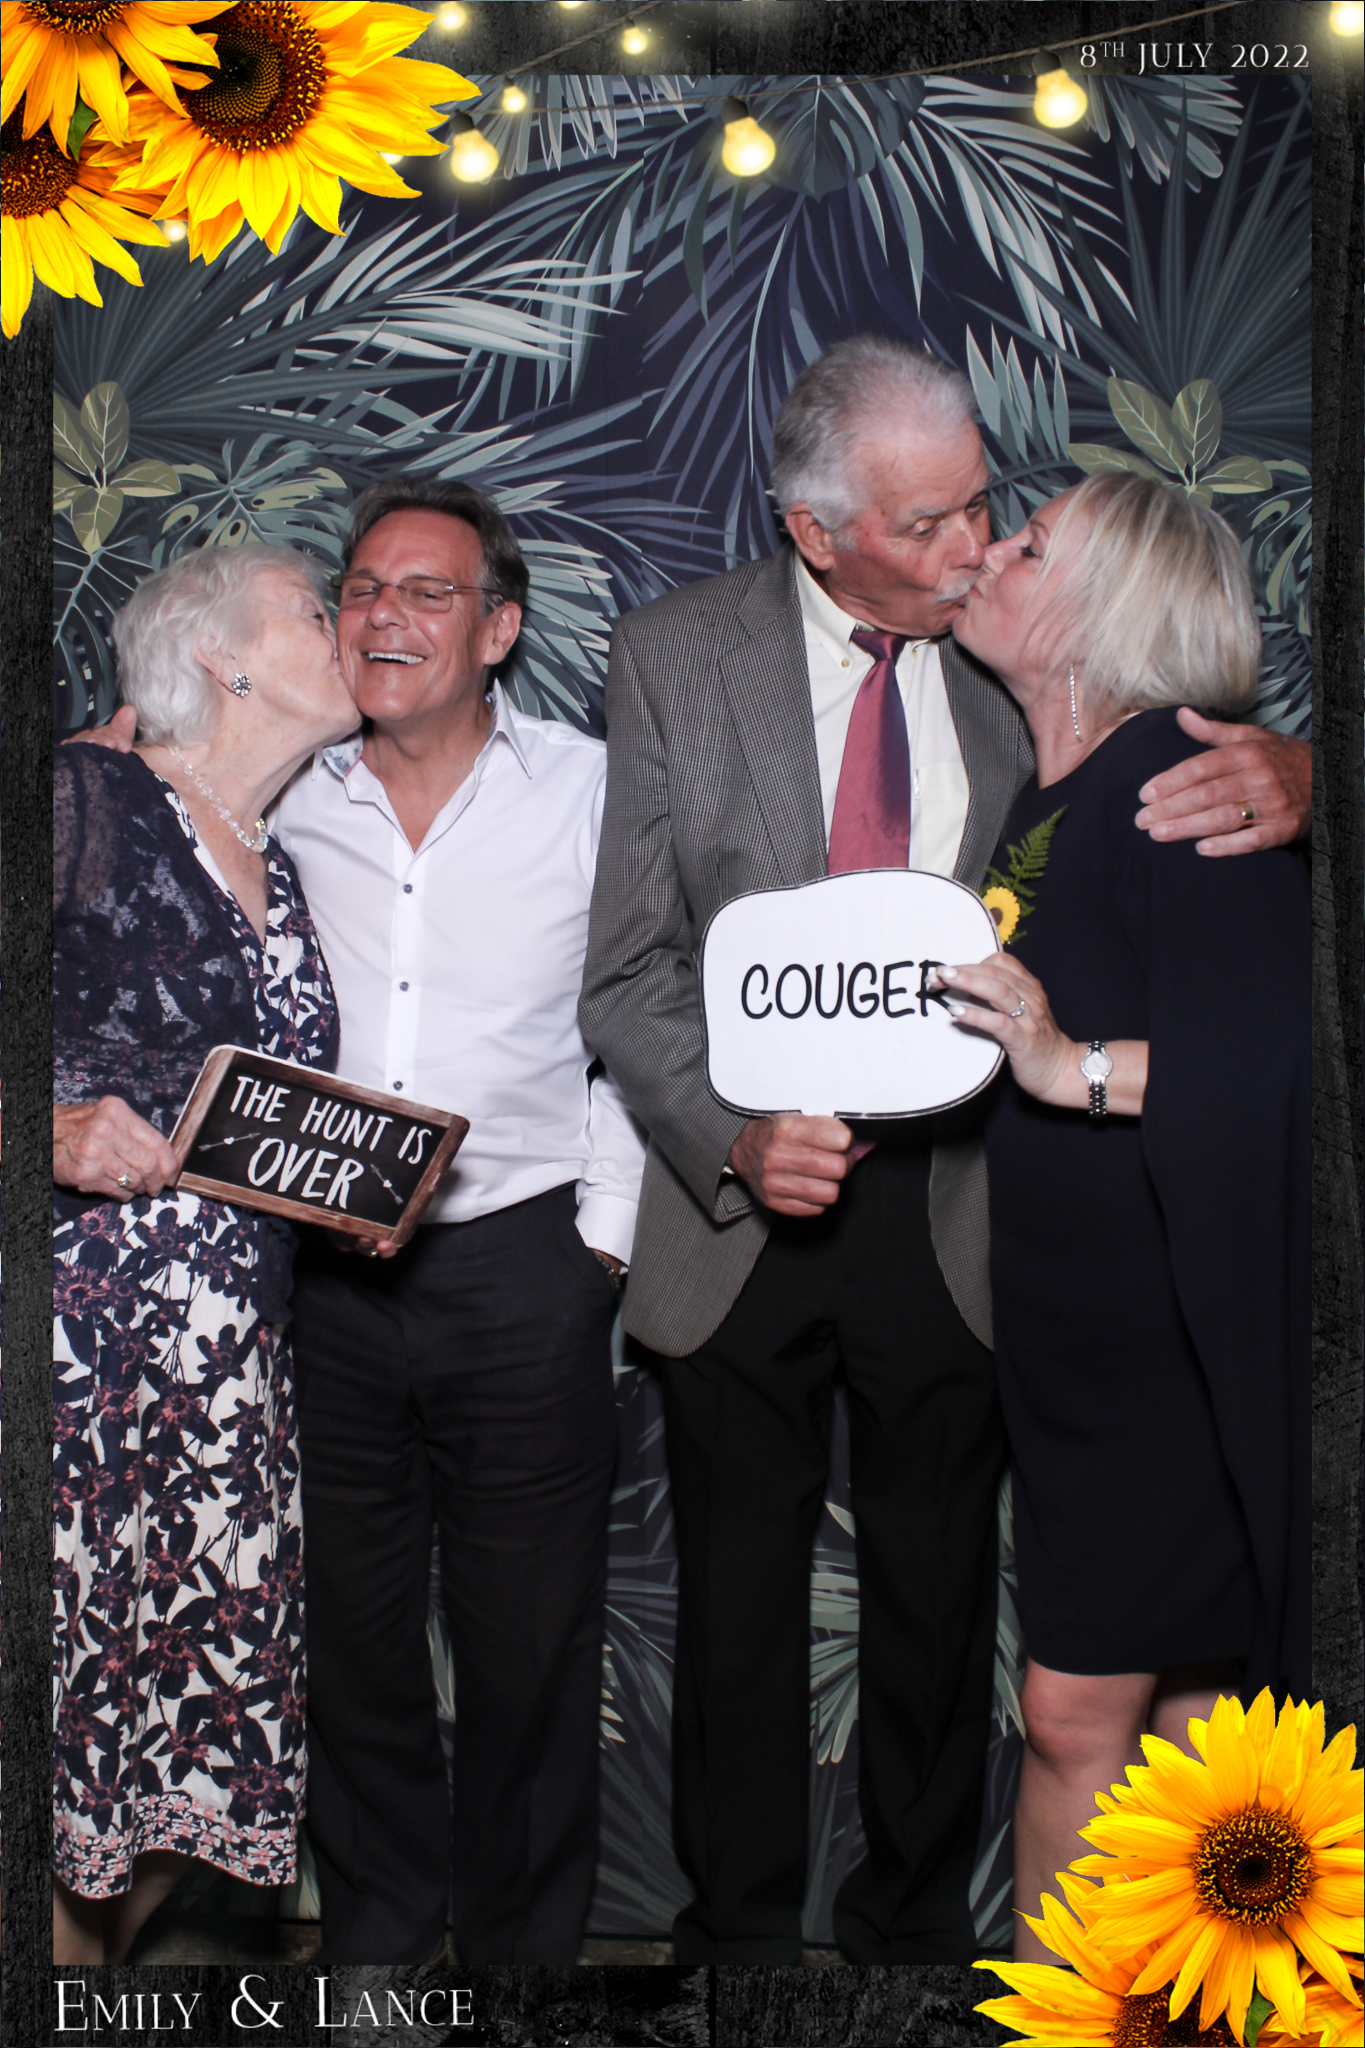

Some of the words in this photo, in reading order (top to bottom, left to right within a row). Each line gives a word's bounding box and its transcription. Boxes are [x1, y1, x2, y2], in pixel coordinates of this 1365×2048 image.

[741, 960, 956, 1019] COUGER
[230, 1076, 291, 1123] THE
[299, 1097, 393, 1151] HUNT
[397, 1126, 432, 1164] IS
[248, 1138, 364, 1209] OVER
